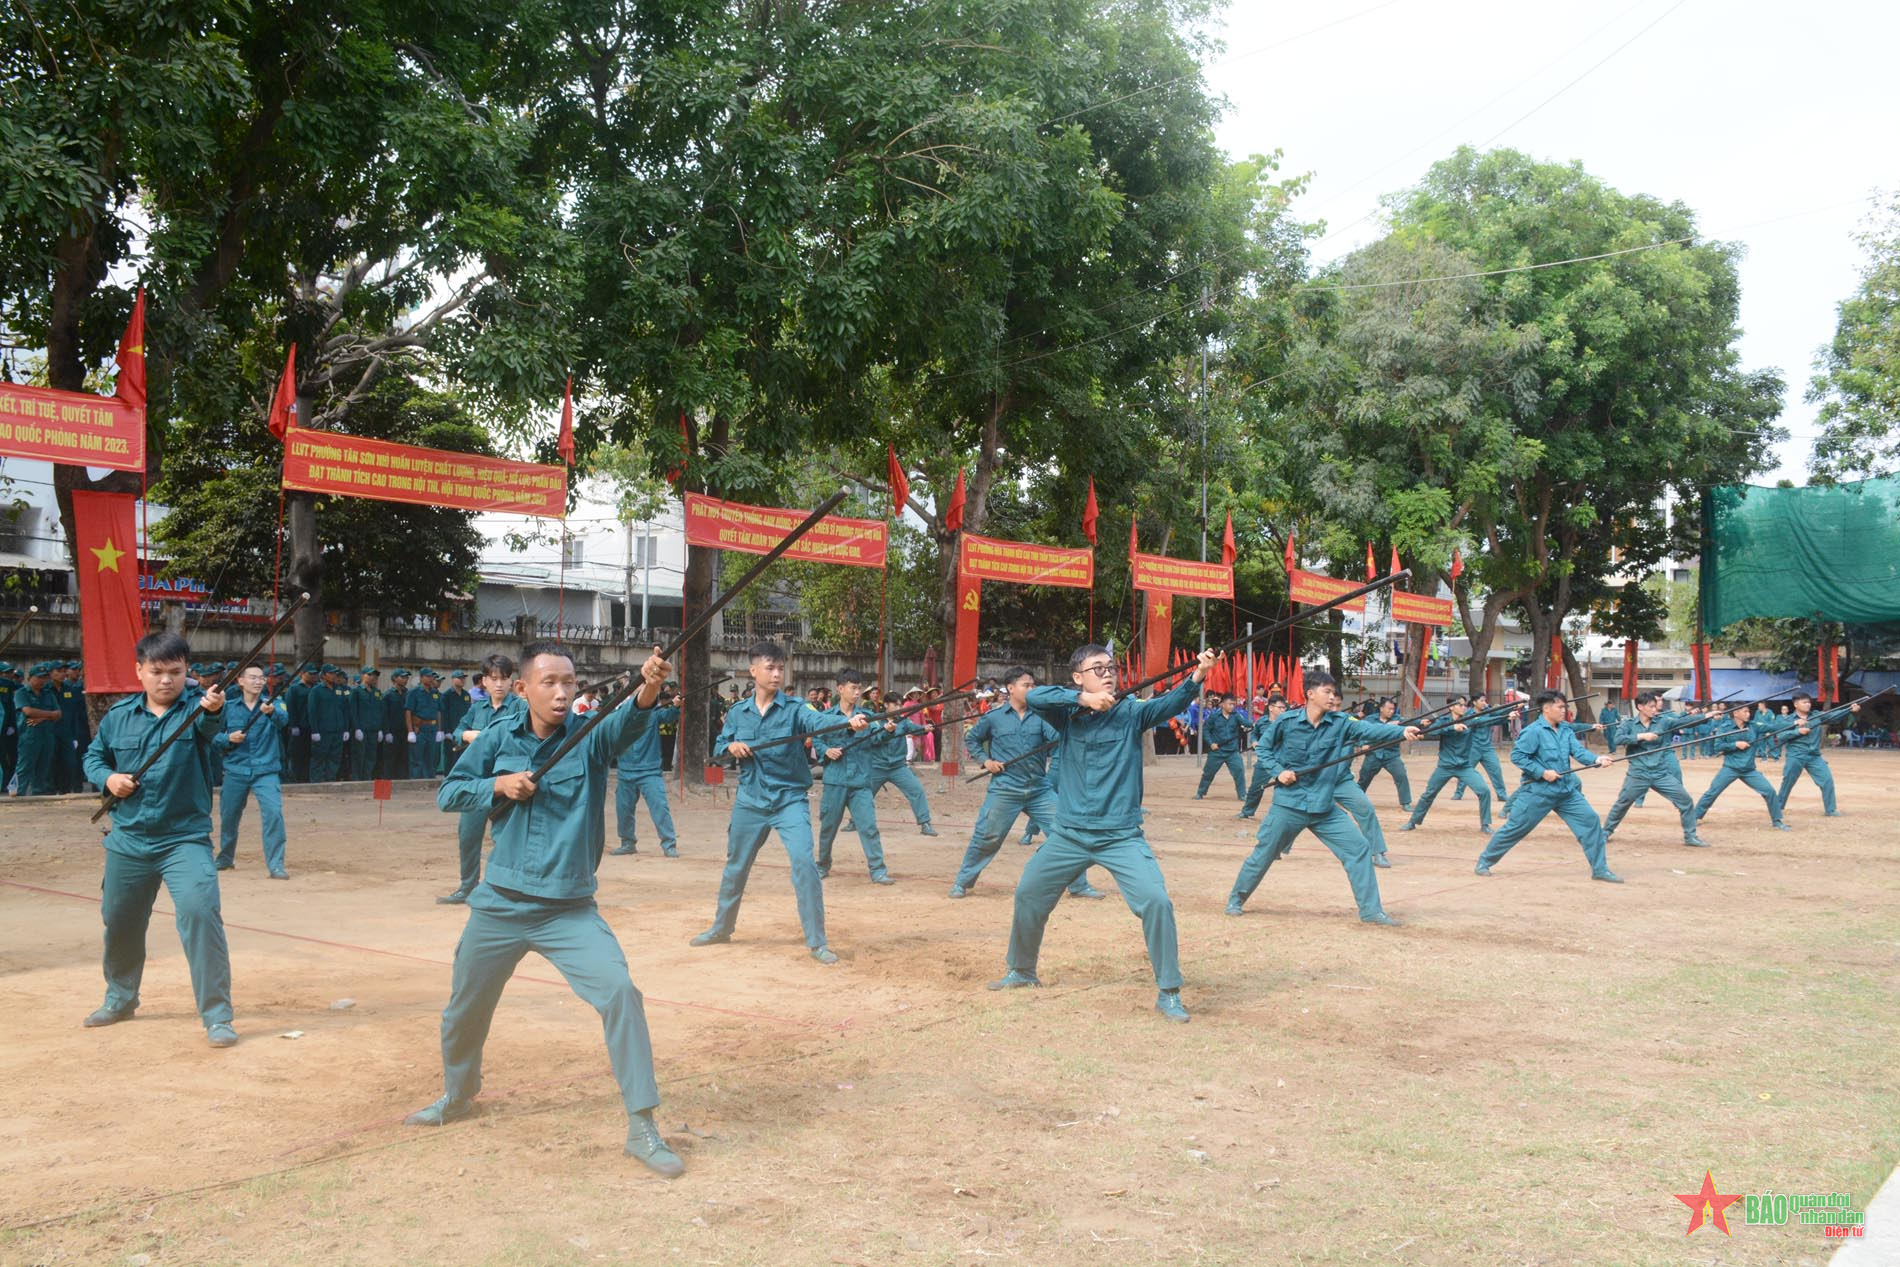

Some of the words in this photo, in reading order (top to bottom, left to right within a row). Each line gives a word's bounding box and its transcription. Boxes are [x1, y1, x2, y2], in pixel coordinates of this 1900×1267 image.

[20, 398, 36, 416] TRÍ
[38, 401, 59, 422] TUỆ,
[62, 404, 91, 425] QUYẾT
[93, 408, 113, 428] TÂM
[15, 424, 42, 444] QUỐC
[44, 427, 78, 448] PHÒNG
[80, 432, 102, 450] NĂM
[104, 437, 129, 454] 2023.
[291, 442, 309, 457] LLVT
[310, 444, 342, 461] PHƯỜNG
[344, 448, 358, 463] TÂN
[360, 451, 375, 466] SƠN
[391, 454, 410, 470] HUẤN
[411, 458, 433, 475] LUYỆN
[434, 460, 451, 476] CHẤT
[308, 464, 324, 482] ĐẠT
[326, 466, 352, 483] THÀNH
[354, 468, 371, 485] TÍCH
[372, 472, 387, 487] CAO
[388, 474, 412, 490] TRONG
[413, 476, 425, 494] HỘI
[441, 480, 453, 497] HỘI
[455, 482, 472, 496] THAO
[473, 484, 492, 500] QUỐC
[492, 487, 515, 503] PHÒNG
[719, 528, 737, 542] QUYẾT
